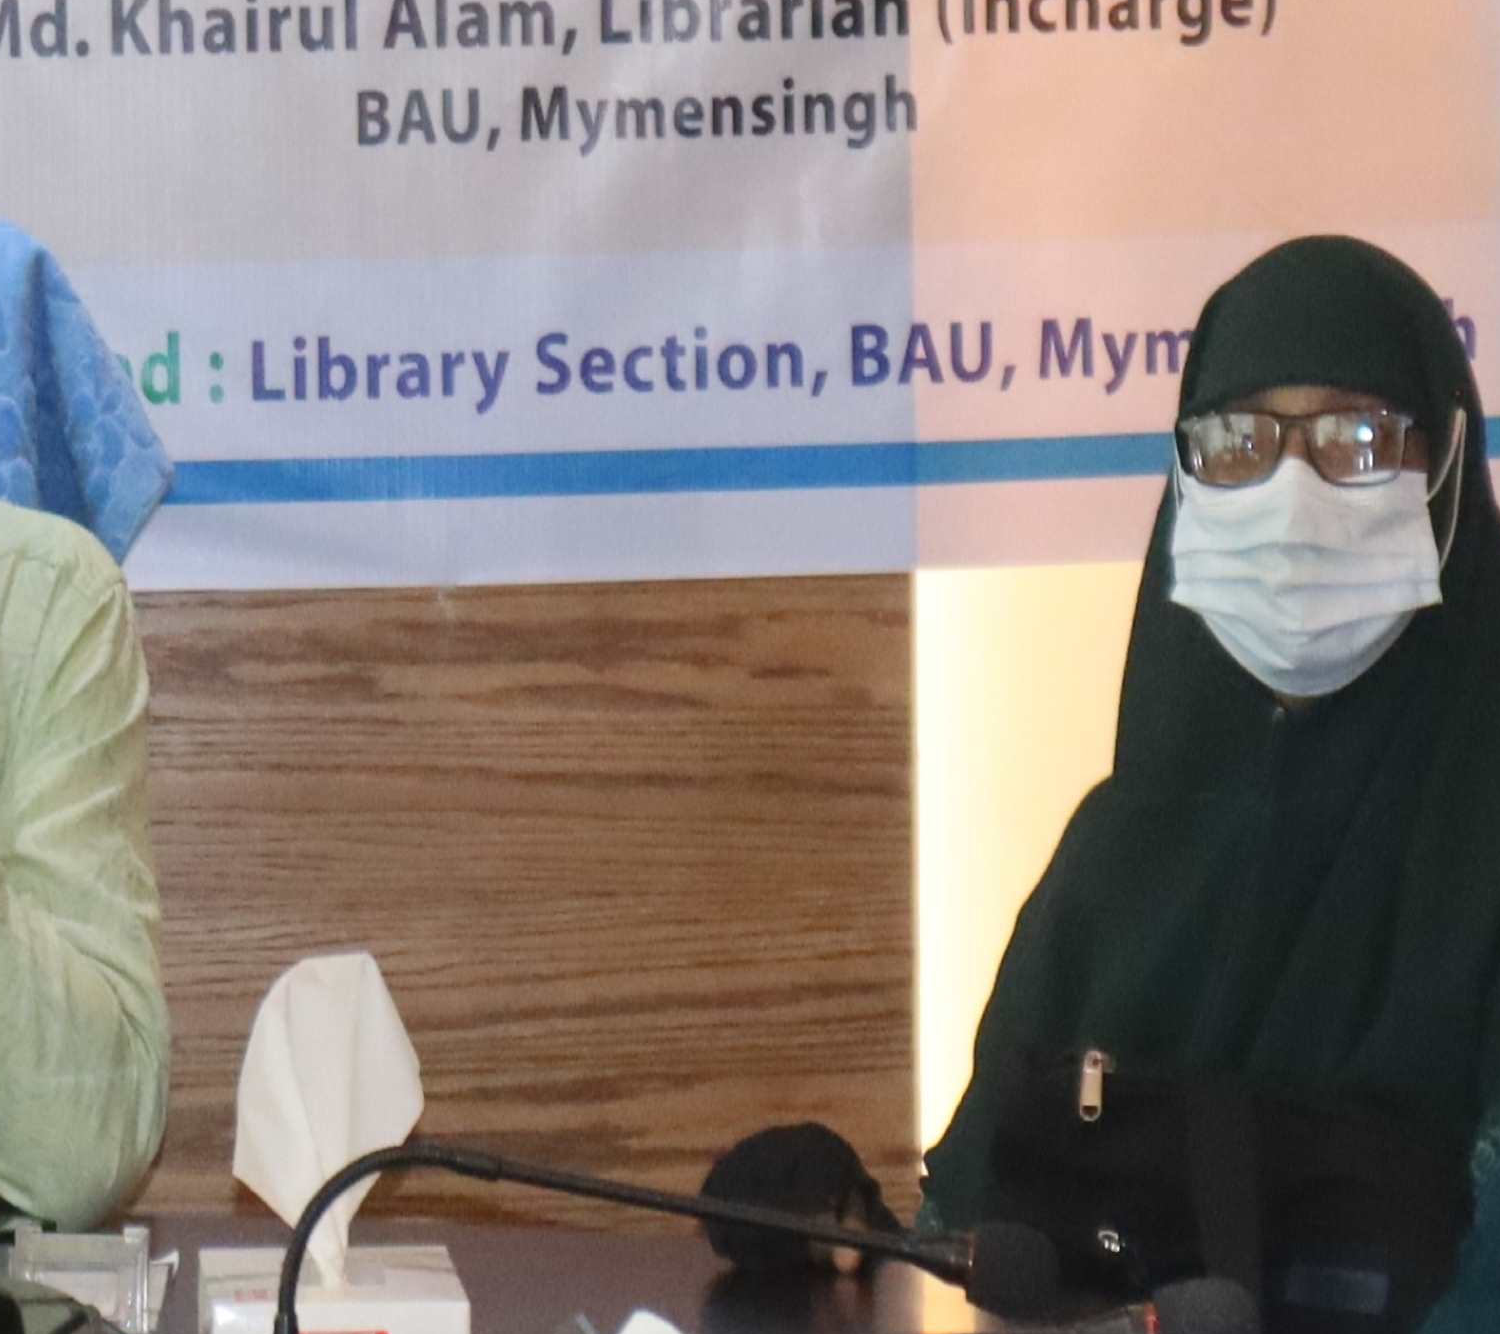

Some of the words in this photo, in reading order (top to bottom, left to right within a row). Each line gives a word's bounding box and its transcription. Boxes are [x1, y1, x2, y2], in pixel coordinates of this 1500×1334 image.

[357, 88, 500, 151] BAU,
[521, 75, 915, 155] Mymensingh
[252, 336, 509, 414] Library
[536, 327, 827, 397] Section,
[851, 322, 1015, 390] BAU,
